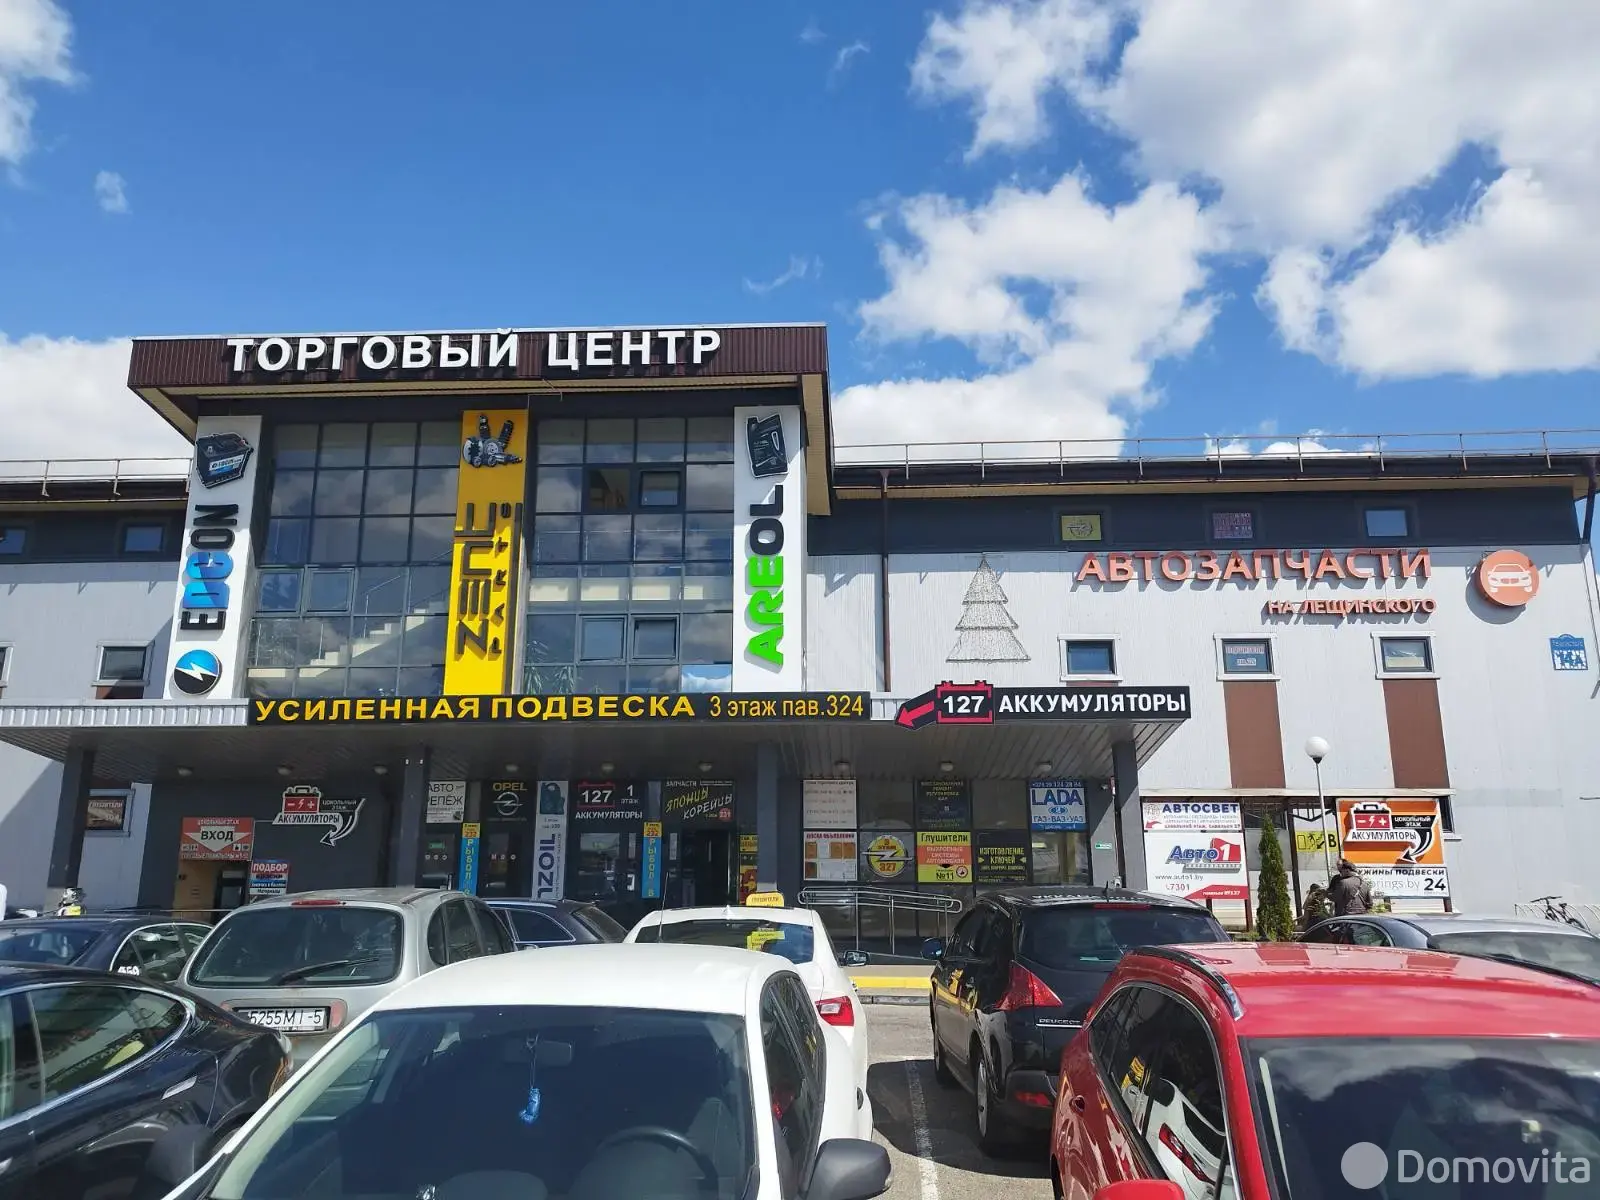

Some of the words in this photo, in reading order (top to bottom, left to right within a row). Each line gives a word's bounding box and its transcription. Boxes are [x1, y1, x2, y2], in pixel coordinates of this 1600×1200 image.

[227, 328, 518, 372] ТОРГОВЫЙ
[548, 330, 721, 370] ЦЕНТР
[180, 504, 239, 631] EDCON
[1076, 548, 1433, 582] АВТОЗАПЧАСТИ
[489, 503, 512, 654] PARTS
[749, 484, 784, 667] AREOL
[1267, 600, 1296, 615] НА
[1298, 599, 1437, 617] ЛЕЩИНСКОГО
[255, 698, 480, 722] УСИЛЕННАЯ
[490, 696, 696, 721] ПОДВЕСКА
[709, 695, 721, 717] 3
[727, 698, 777, 717] этаж
[782, 695, 865, 717] пав.324
[943, 695, 985, 714] 127
[998, 693, 1187, 713] АККУМУЛЯТОРЫ
[492, 782, 528, 791] OPEL
[581, 790, 613, 803] 127
[1031, 789, 1083, 806] LADA
[575, 811, 643, 820] АККУМУЛЯТОРЫ
[1162, 803, 1239, 814] АВТОСВЕТ
[200, 830, 235, 842] ВХОД
[920, 833, 968, 844] Глушители
[252, 862, 288, 873] ПОДБОР
[1395, 868, 1445, 876] ПОДВЕСКИ
[1423, 878, 1446, 891] 24
